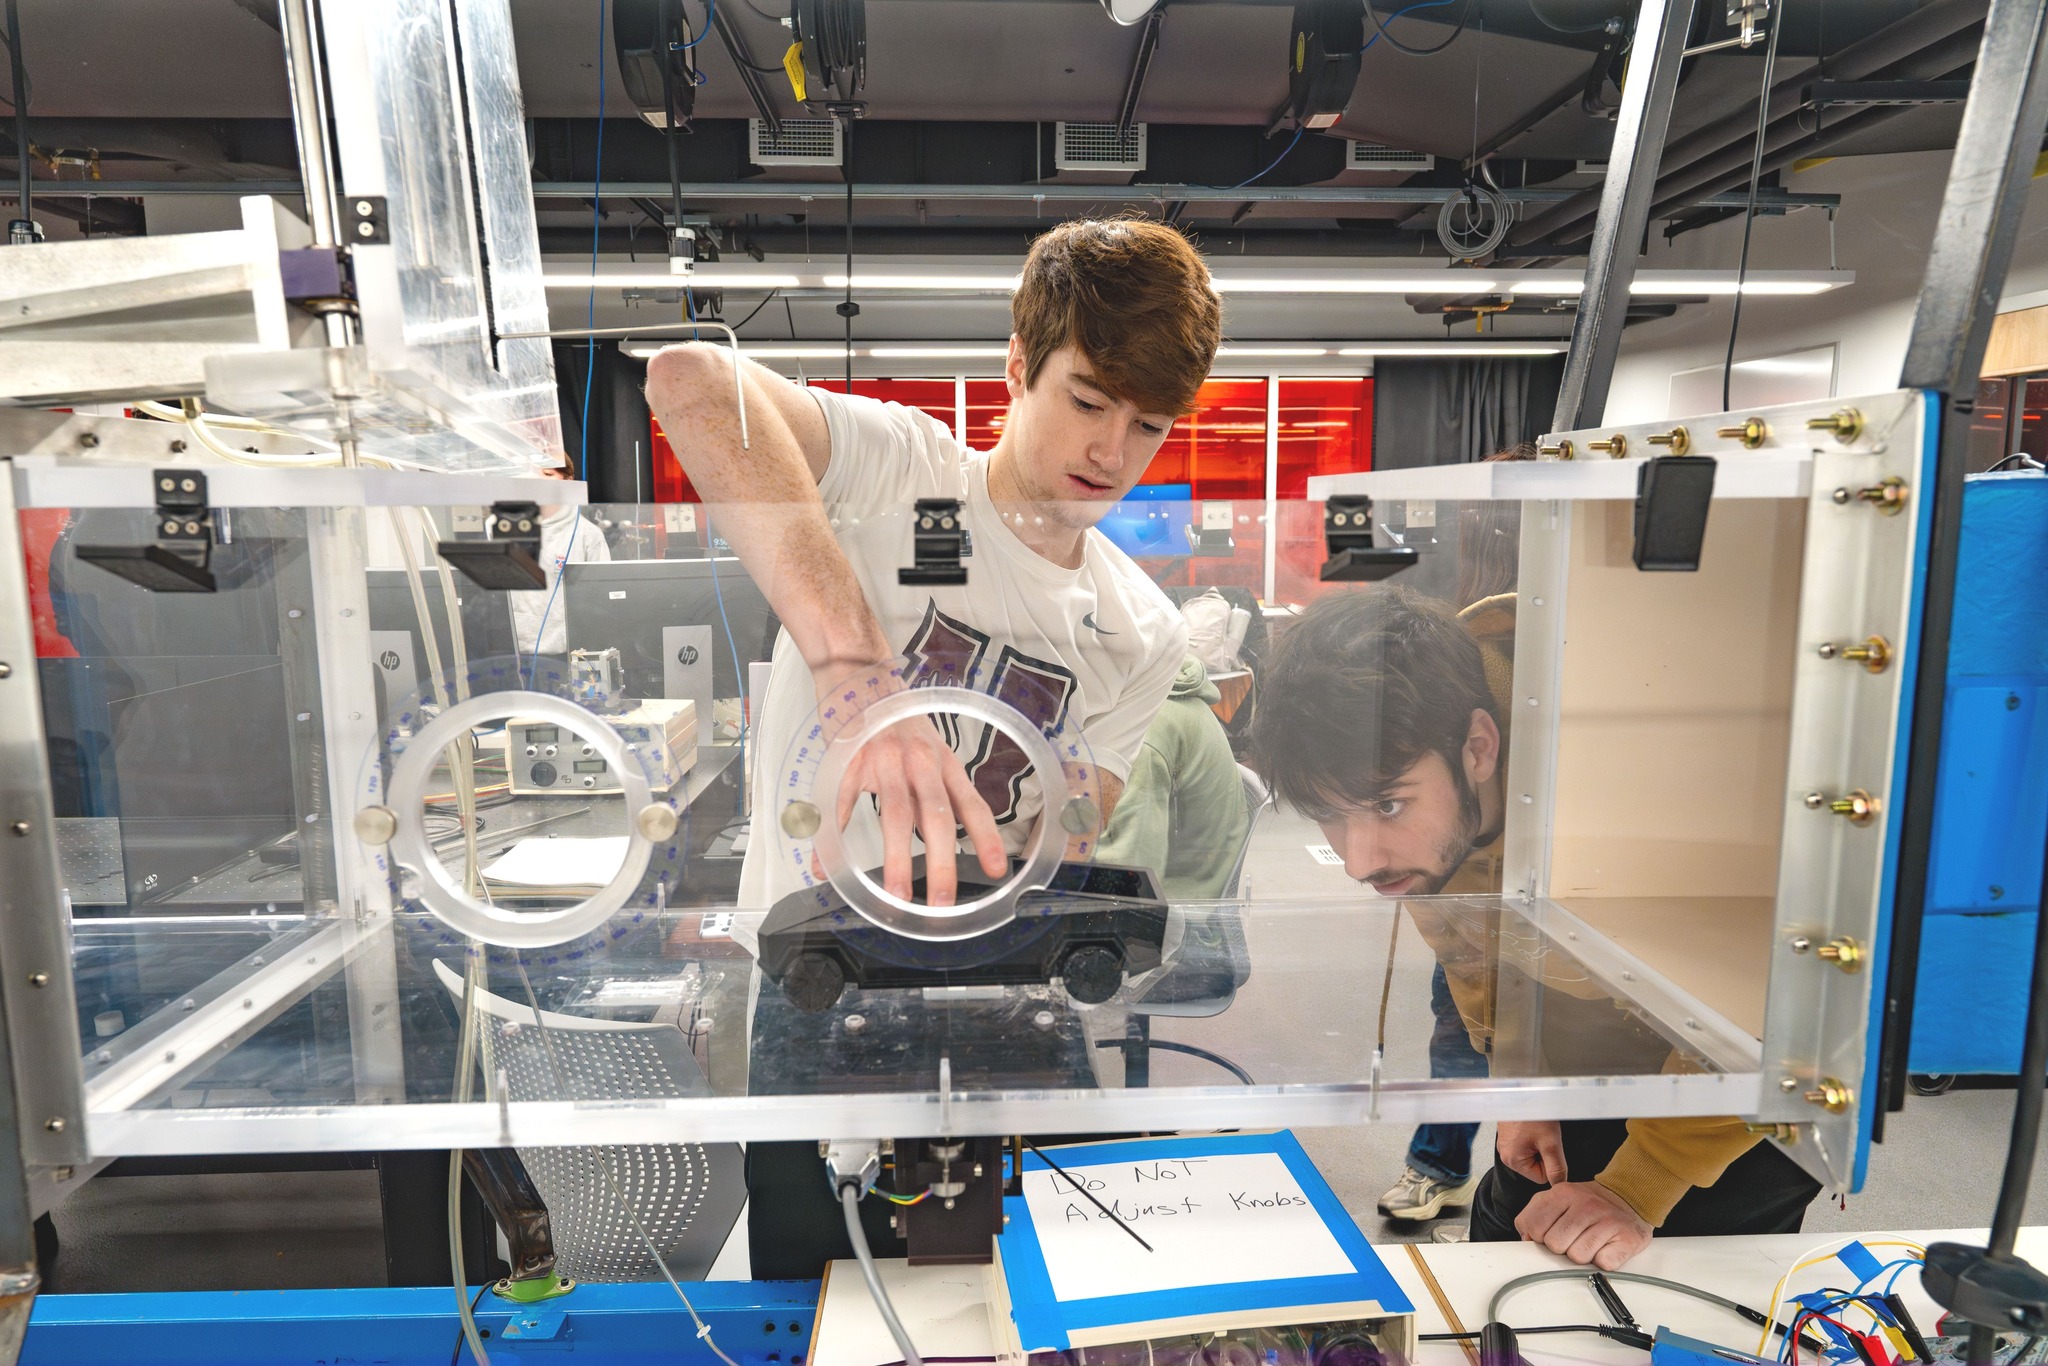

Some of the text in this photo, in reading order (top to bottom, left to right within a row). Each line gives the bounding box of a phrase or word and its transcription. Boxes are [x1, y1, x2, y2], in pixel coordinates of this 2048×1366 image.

[381, 650, 399, 670] hp
[679, 645, 697, 665] hp
[1050, 1171, 1106, 1195] Do
[1065, 1191, 1307, 1222] Adjust Knobs
